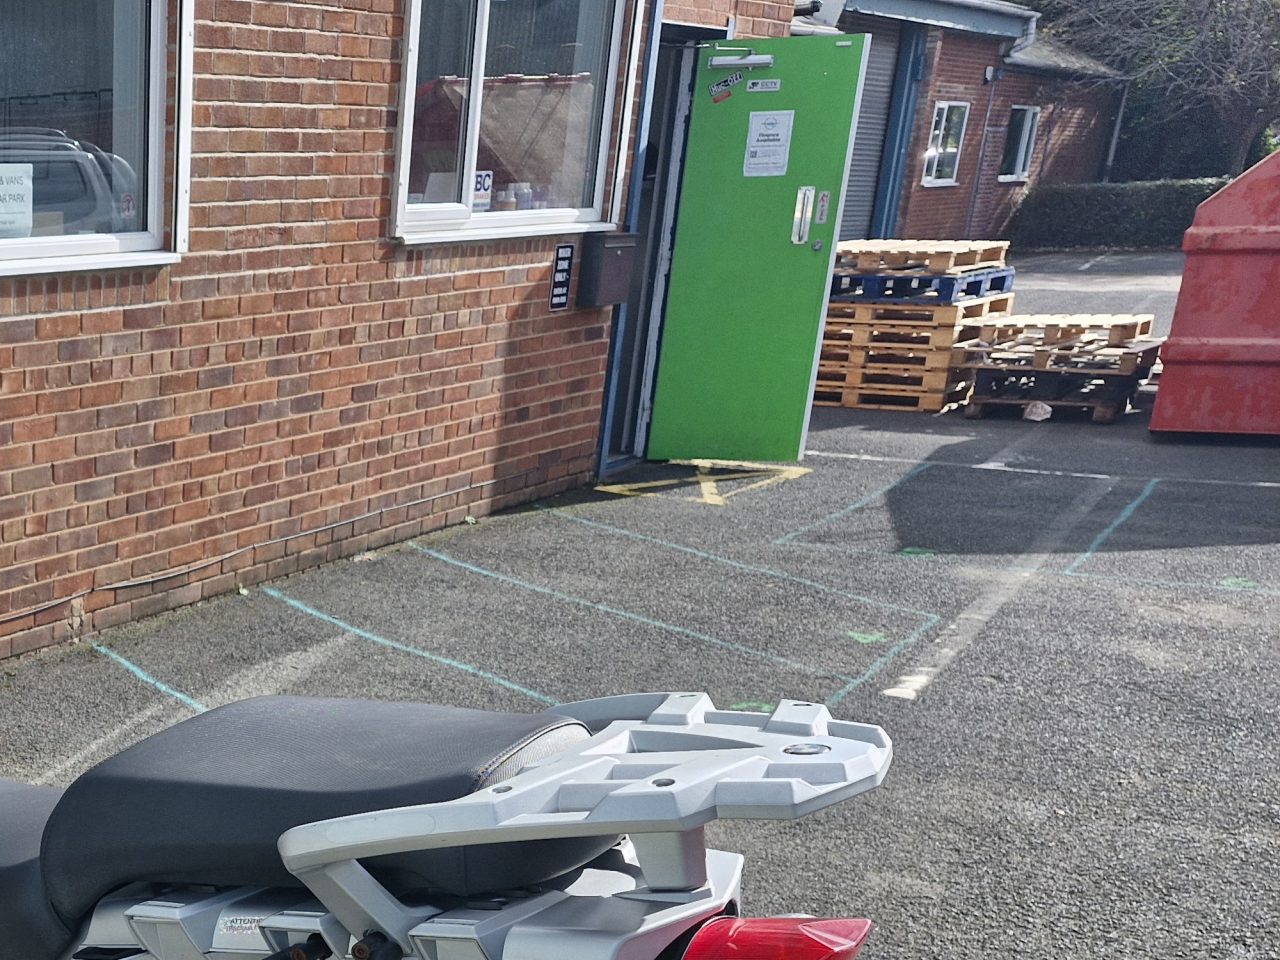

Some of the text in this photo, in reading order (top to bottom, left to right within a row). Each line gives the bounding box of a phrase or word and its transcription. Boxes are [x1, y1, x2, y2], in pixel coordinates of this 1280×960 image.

[0, 176, 5, 186] &
[5, 176, 24, 185] VANS
[474, 174, 491, 192] BC
[8, 194, 25, 203] PARK
